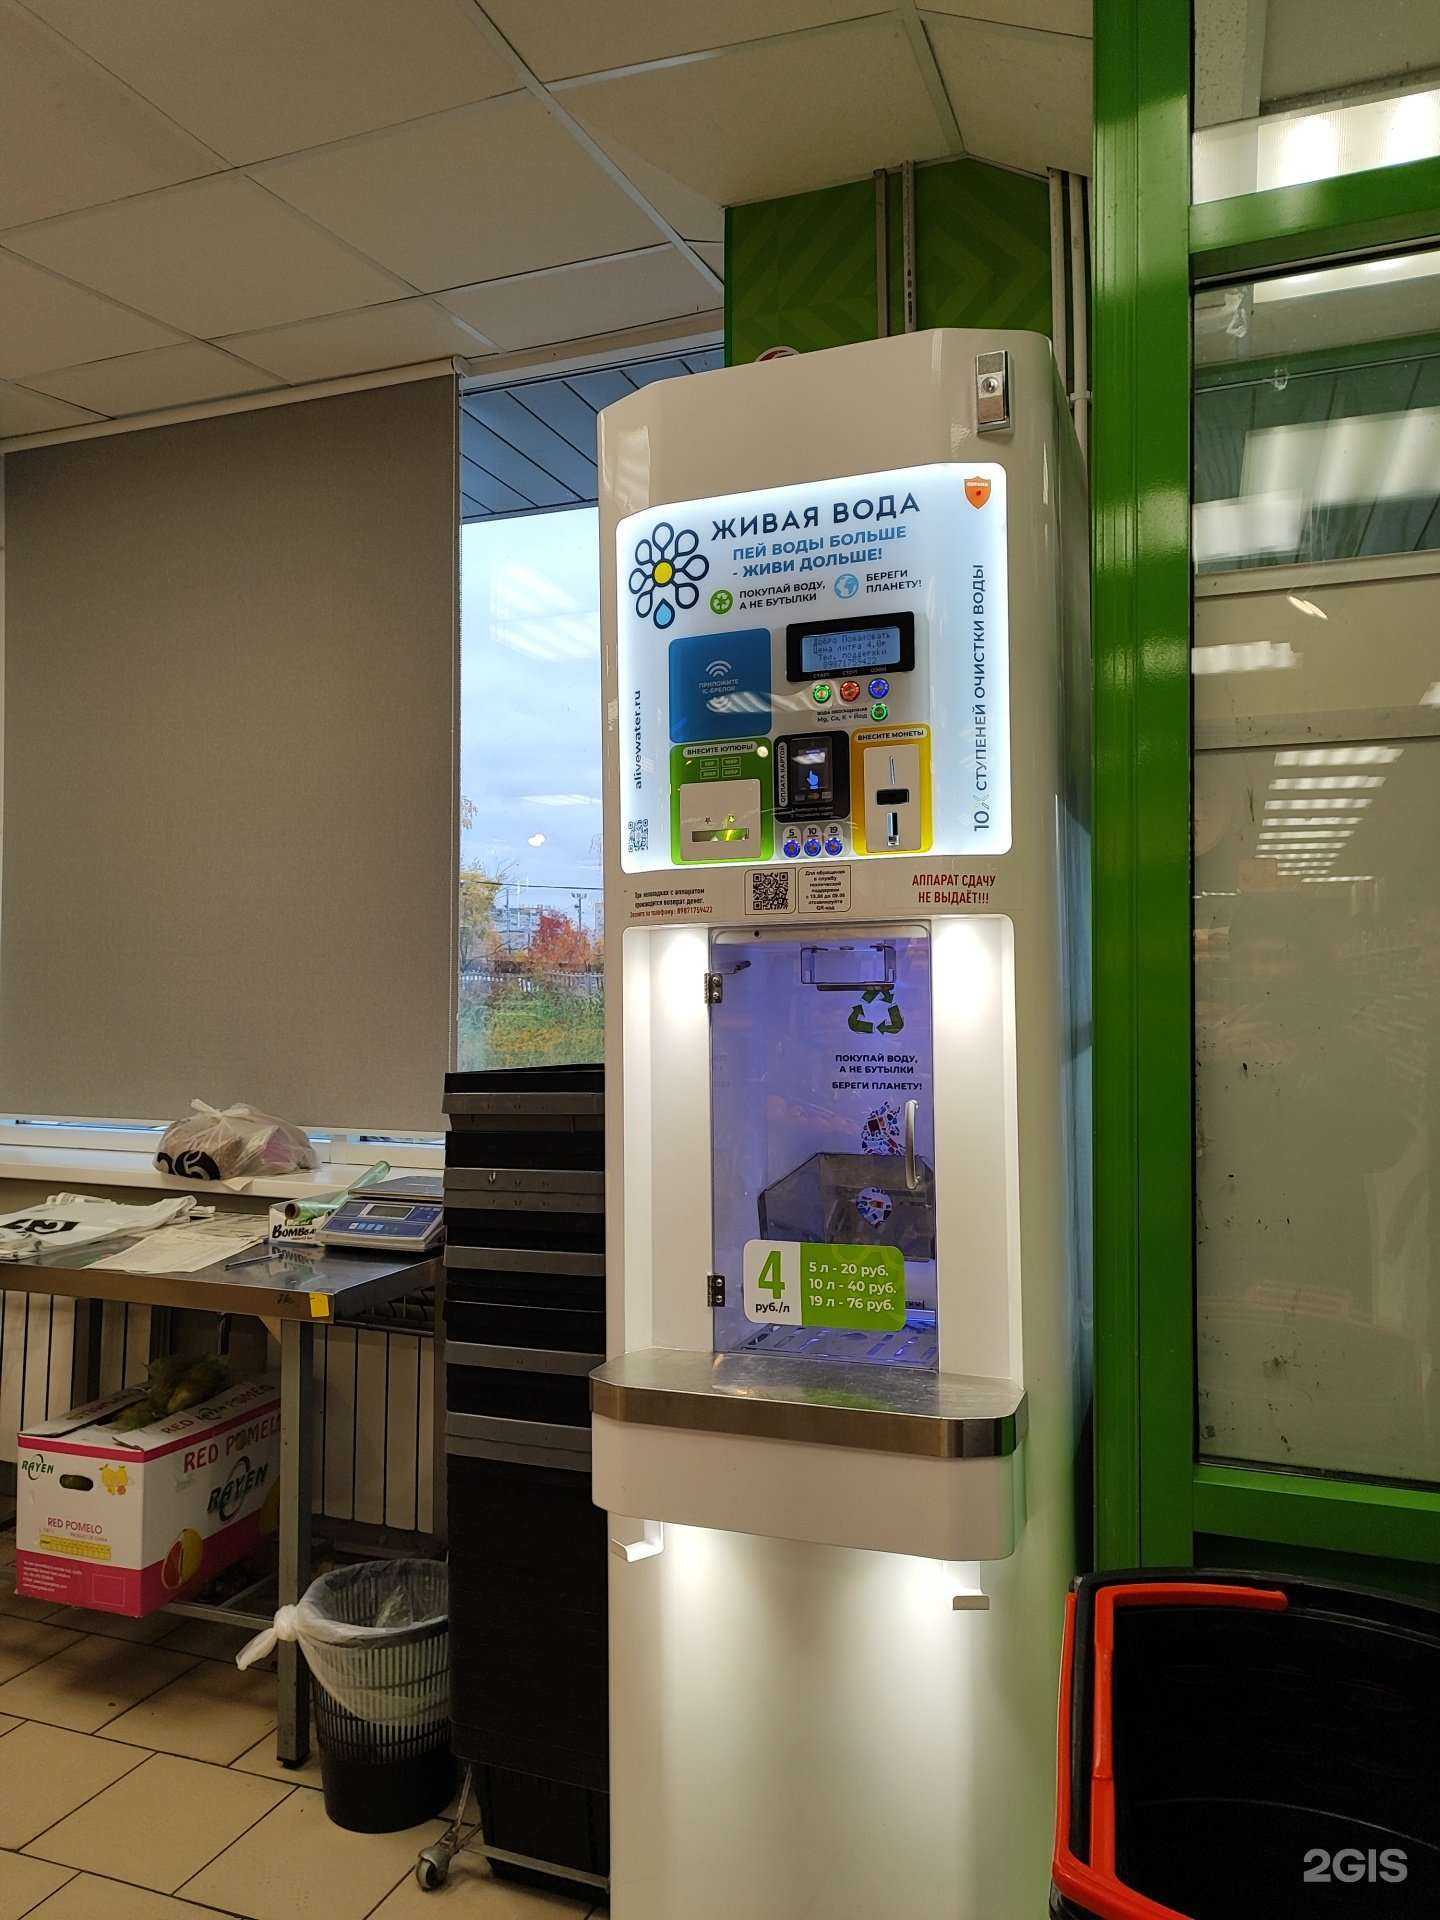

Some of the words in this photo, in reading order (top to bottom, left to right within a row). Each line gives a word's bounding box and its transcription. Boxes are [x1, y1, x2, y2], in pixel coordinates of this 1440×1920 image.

[711, 506, 819, 541] ЖИВАЯ
[833, 492, 920, 524] ВОДА
[733, 542, 766, 561] ПЕЙ
[772, 537, 824, 557] ВОДЫ
[830, 526, 907, 548] БОЛЬШЕ
[742, 560, 795, 578] ЖИВИ
[799, 547, 883, 573] ДОЛЬШЕ!
[866, 569, 908, 583] БЕРЕГИ
[739, 583, 791, 599] ПОКУПАЙ
[793, 580, 826, 592] ВОДУ,
[866, 580, 922, 594] ПЛАНЕТУ!
[973, 564, 986, 615] ВОДЫ
[739, 602, 747, 610] А
[749, 600, 764, 609] НЕ
[765, 593, 817, 607] БУТЫЛКИ
[973, 620, 986, 699] ОЧИСТКИ
[634, 690, 642, 790] alivewater.ru
[858, 732, 891, 741] ВНЕСИТЕ
[892, 730, 924, 739] МОНЕТЫ
[687, 746, 719, 756] ВНЕСИТЕ
[721, 744, 753, 753] КУПЮРЫ
[972, 704, 988, 791] СТУПЕНЕЙ
[974, 810, 990, 832] 10
[789, 828, 795, 836] 5
[808, 827, 817, 835] 10
[912, 874, 959, 886] АППАРАТ
[961, 874, 996, 888] СДАЧУ
[918, 891, 931, 903] НЕ
[934, 889, 989, 905] ВЫДАЁТ!!!
[835, 1053, 884, 1062] ПОКУПАЙ
[887, 1055, 918, 1064] ВОДУ,
[865, 1066, 914, 1074] БУТЫЛКИ
[832, 1081, 869, 1090] БЕРЕГИ
[872, 1082, 922, 1091] ПЛАНЕТУ!
[758, 1250, 786, 1300] 4
[809, 1262, 817, 1273] 5
[819, 1264, 829, 1273] л
[841, 1263, 857, 1274] 20
[861, 1265, 889, 1278] руб.
[809, 1278, 823, 1289] 10
[826, 1281, 836, 1290] л
[847, 1281, 865, 1292] 40
[869, 1282, 897, 1295] руб.
[755, 1302, 790, 1314] руб./л
[809, 1295, 823, 1306] 19
[826, 1299, 836, 1307] л
[847, 1298, 863, 1309] 76
[867, 1300, 895, 1313] руб.
[184, 1443, 219, 1473] RED
[22, 1457, 54, 1477] RAYEN
[207, 1458, 268, 1517] RAYEN
[48, 1517, 63, 1529] RED
[65, 1520, 103, 1535] POMELO
